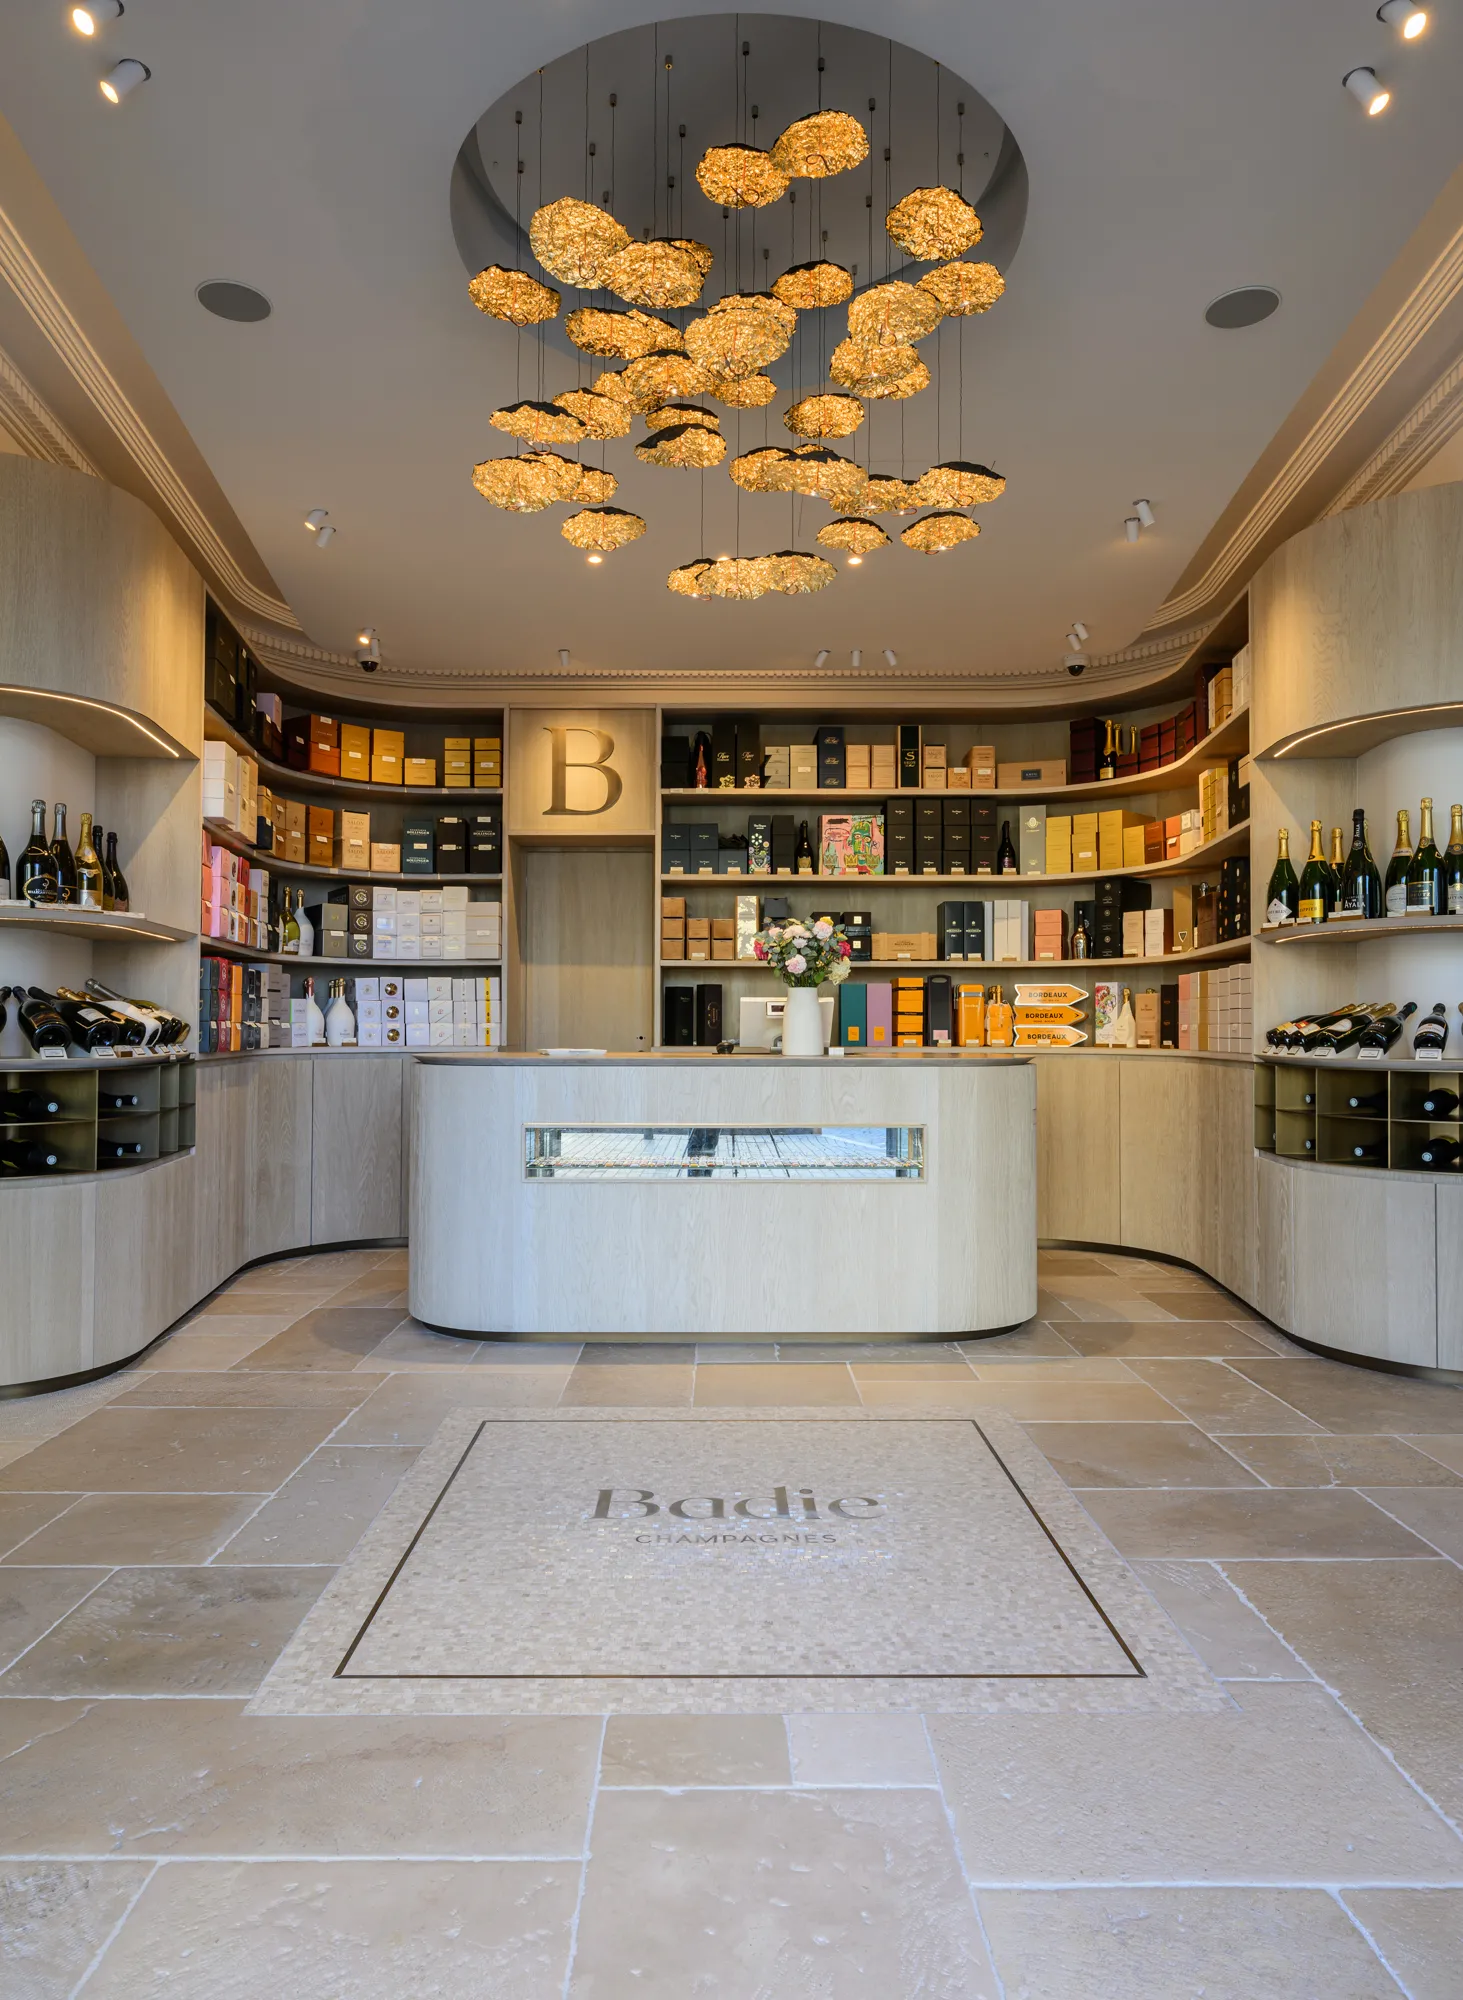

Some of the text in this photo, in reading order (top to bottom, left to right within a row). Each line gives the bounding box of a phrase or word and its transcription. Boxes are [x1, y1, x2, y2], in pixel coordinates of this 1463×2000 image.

[904, 751, 915, 761] S
[541, 727, 623, 816] B
[1344, 900, 1366, 909] AYALA
[589, 1486, 885, 1520] Badie
[635, 1534, 837, 1544] CHAMPAGNES
